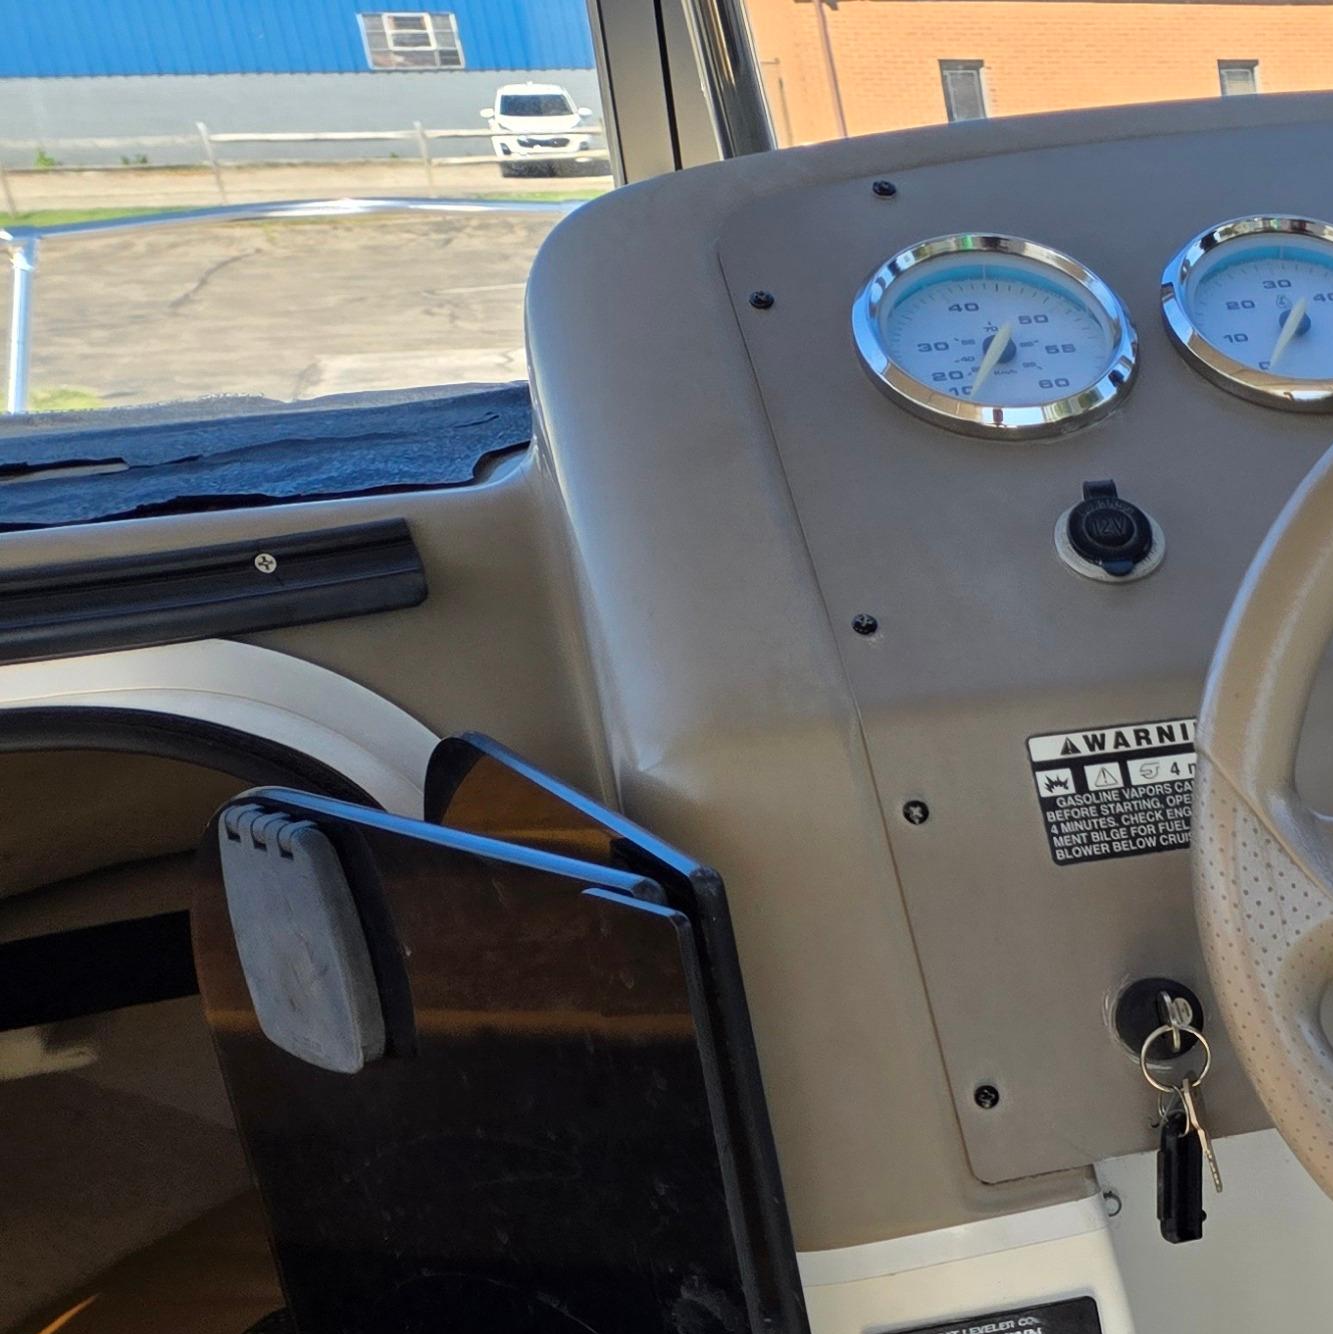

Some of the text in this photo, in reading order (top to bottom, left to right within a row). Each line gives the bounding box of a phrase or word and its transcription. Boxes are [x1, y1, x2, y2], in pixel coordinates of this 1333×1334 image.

[1263, 279, 1292, 290] 30
[948, 302, 980, 312] 40
[1226, 300, 1256, 310] 20
[1018, 314, 1048, 325] 50
[1224, 333, 1248, 344] 10
[917, 342, 950, 352] 30
[1045, 344, 1076, 354] 55
[932, 370, 964, 382] 20
[1039, 378, 1070, 388] 60
[1082, 722, 1196, 752] WARNI
[1170, 762, 1180, 776] 4
[1056, 781, 1194, 808] GASOLINE VAPORS CA
[1046, 806, 1099, 822] BEFORE
[1050, 806, 1192, 835] 4 CHECK ENG
[1052, 820, 1190, 848] MENT BILGE FOR FUEL
[1056, 844, 1110, 860] BLOWER
[1112, 836, 1158, 852] BELOW
